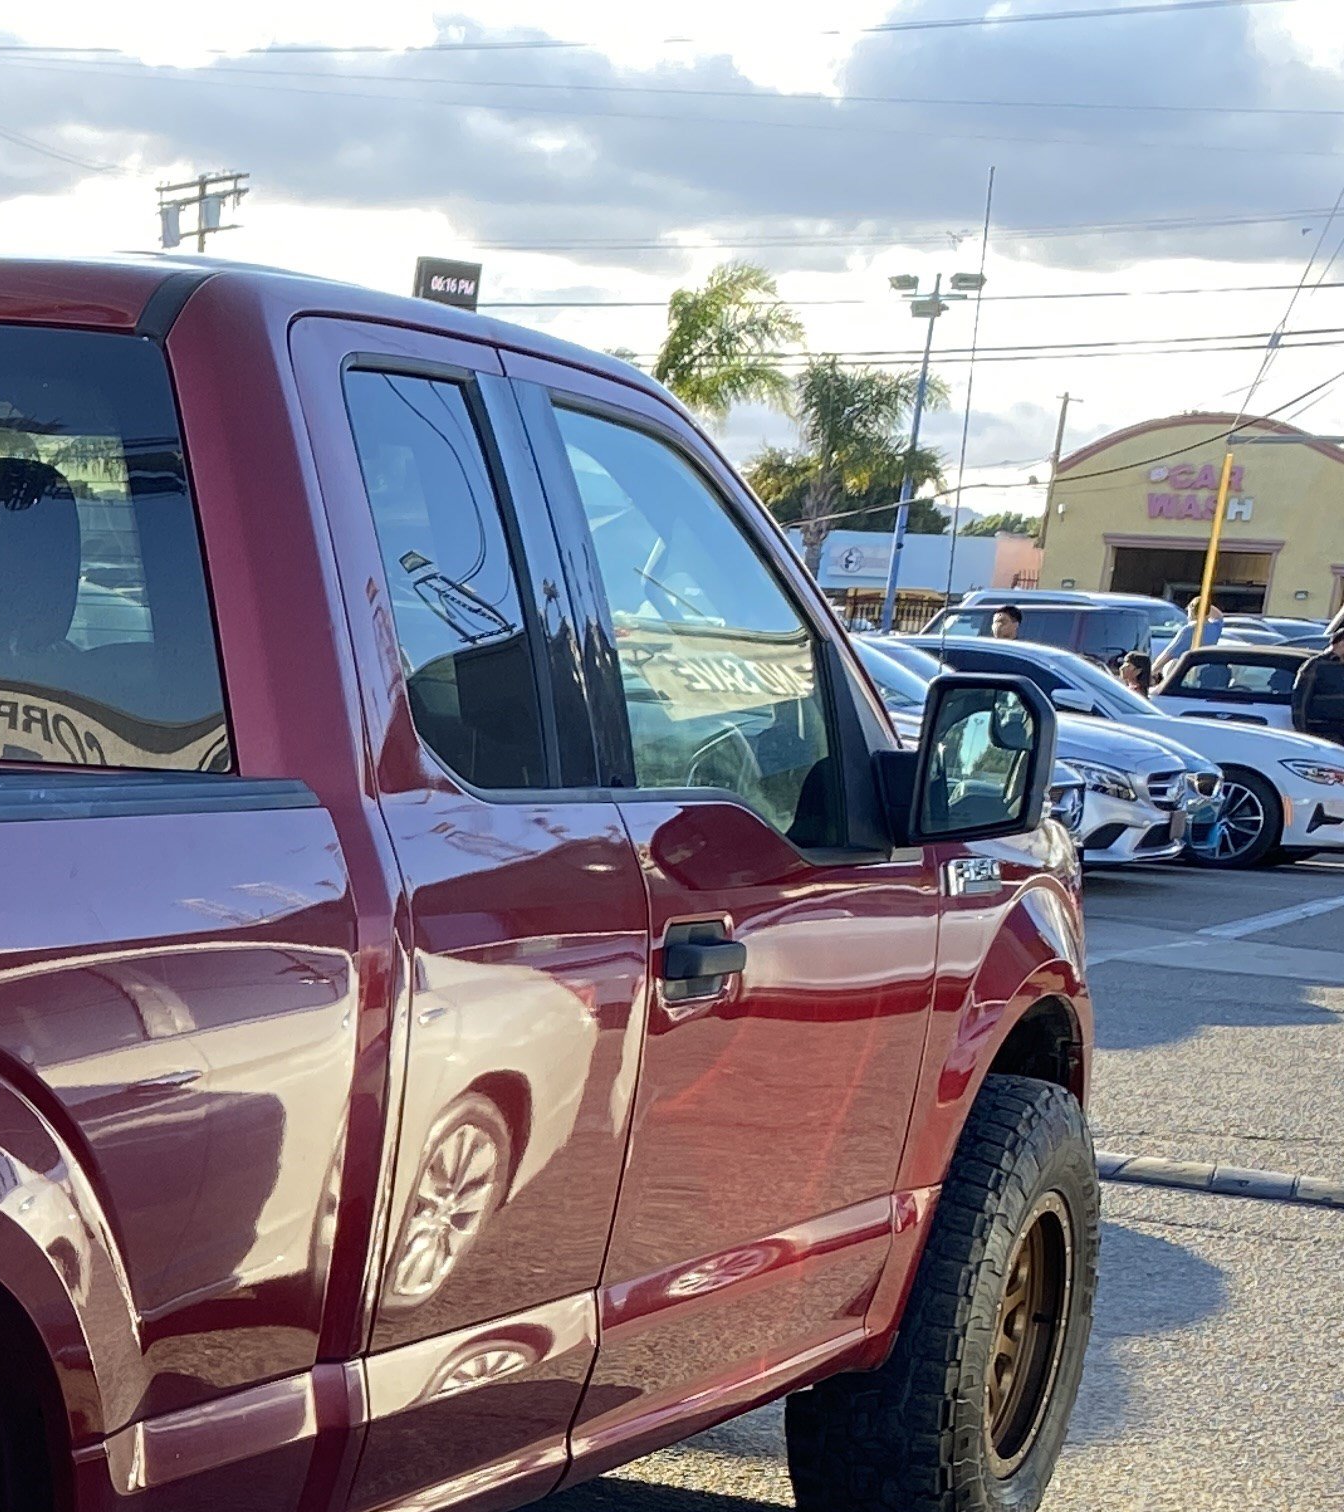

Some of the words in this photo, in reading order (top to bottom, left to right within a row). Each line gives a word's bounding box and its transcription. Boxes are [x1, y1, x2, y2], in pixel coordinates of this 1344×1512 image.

[458, 279, 475, 295] PM
[1170, 464, 1244, 491] CAR
[1148, 493, 1253, 521] WASH
